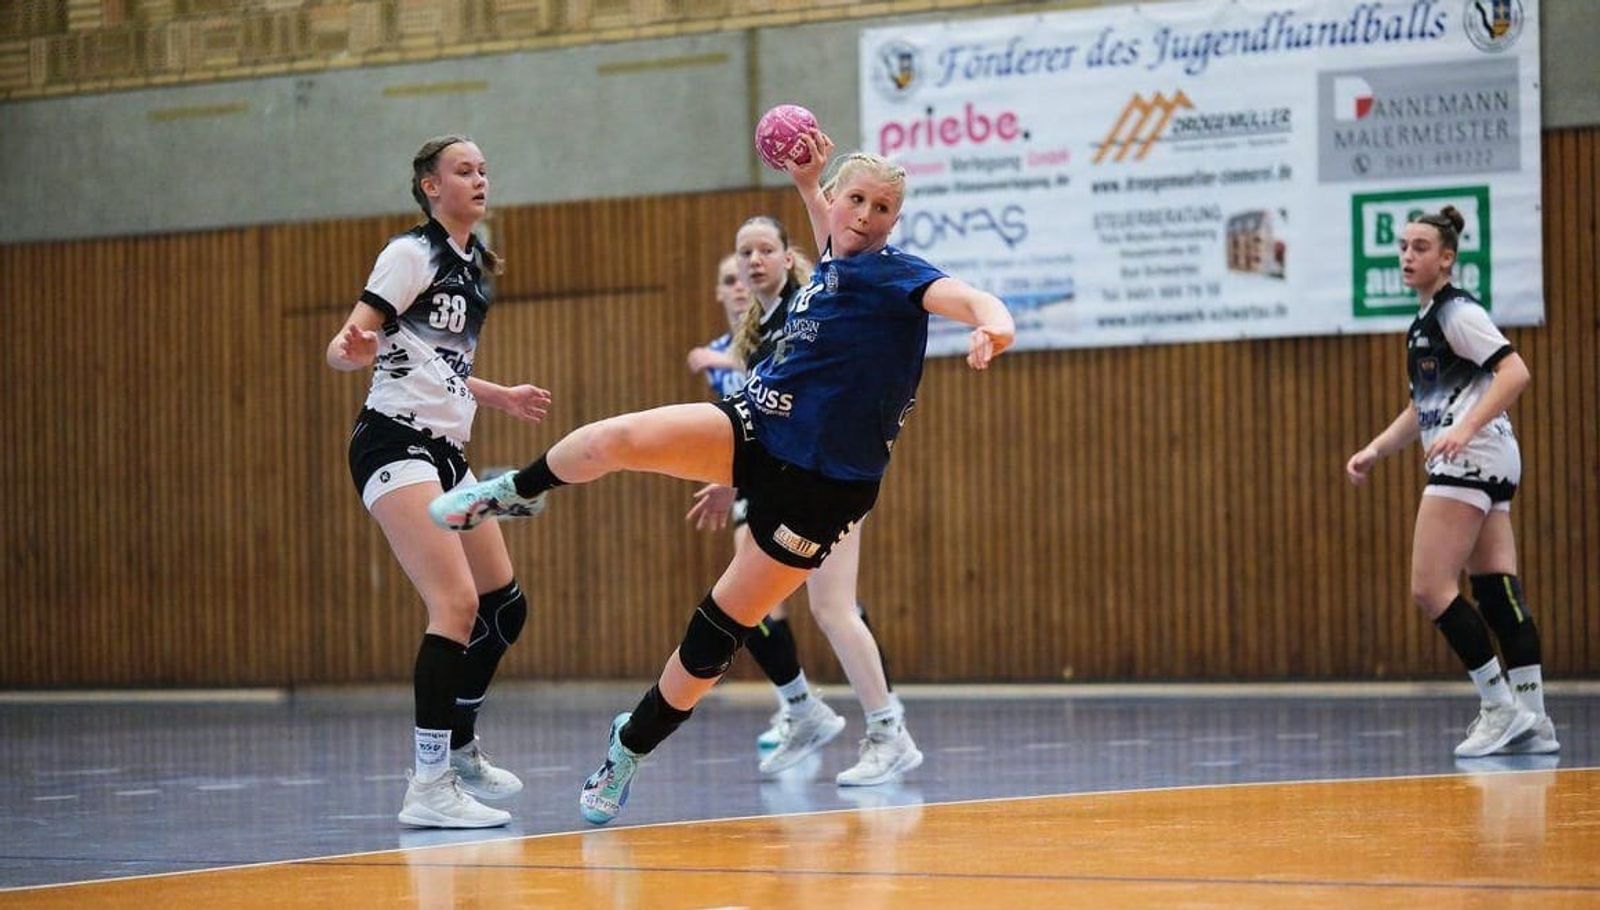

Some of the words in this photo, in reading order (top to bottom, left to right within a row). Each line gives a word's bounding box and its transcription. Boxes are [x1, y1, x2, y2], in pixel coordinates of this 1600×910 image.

[935, 35, 1076, 88] Förderer
[1086, 27, 1141, 69] des
[1147, 0, 1447, 76] Jugendhandballs
[1334, 118, 1510, 150] MALERMEISTER
[427, 291, 468, 333] 38
